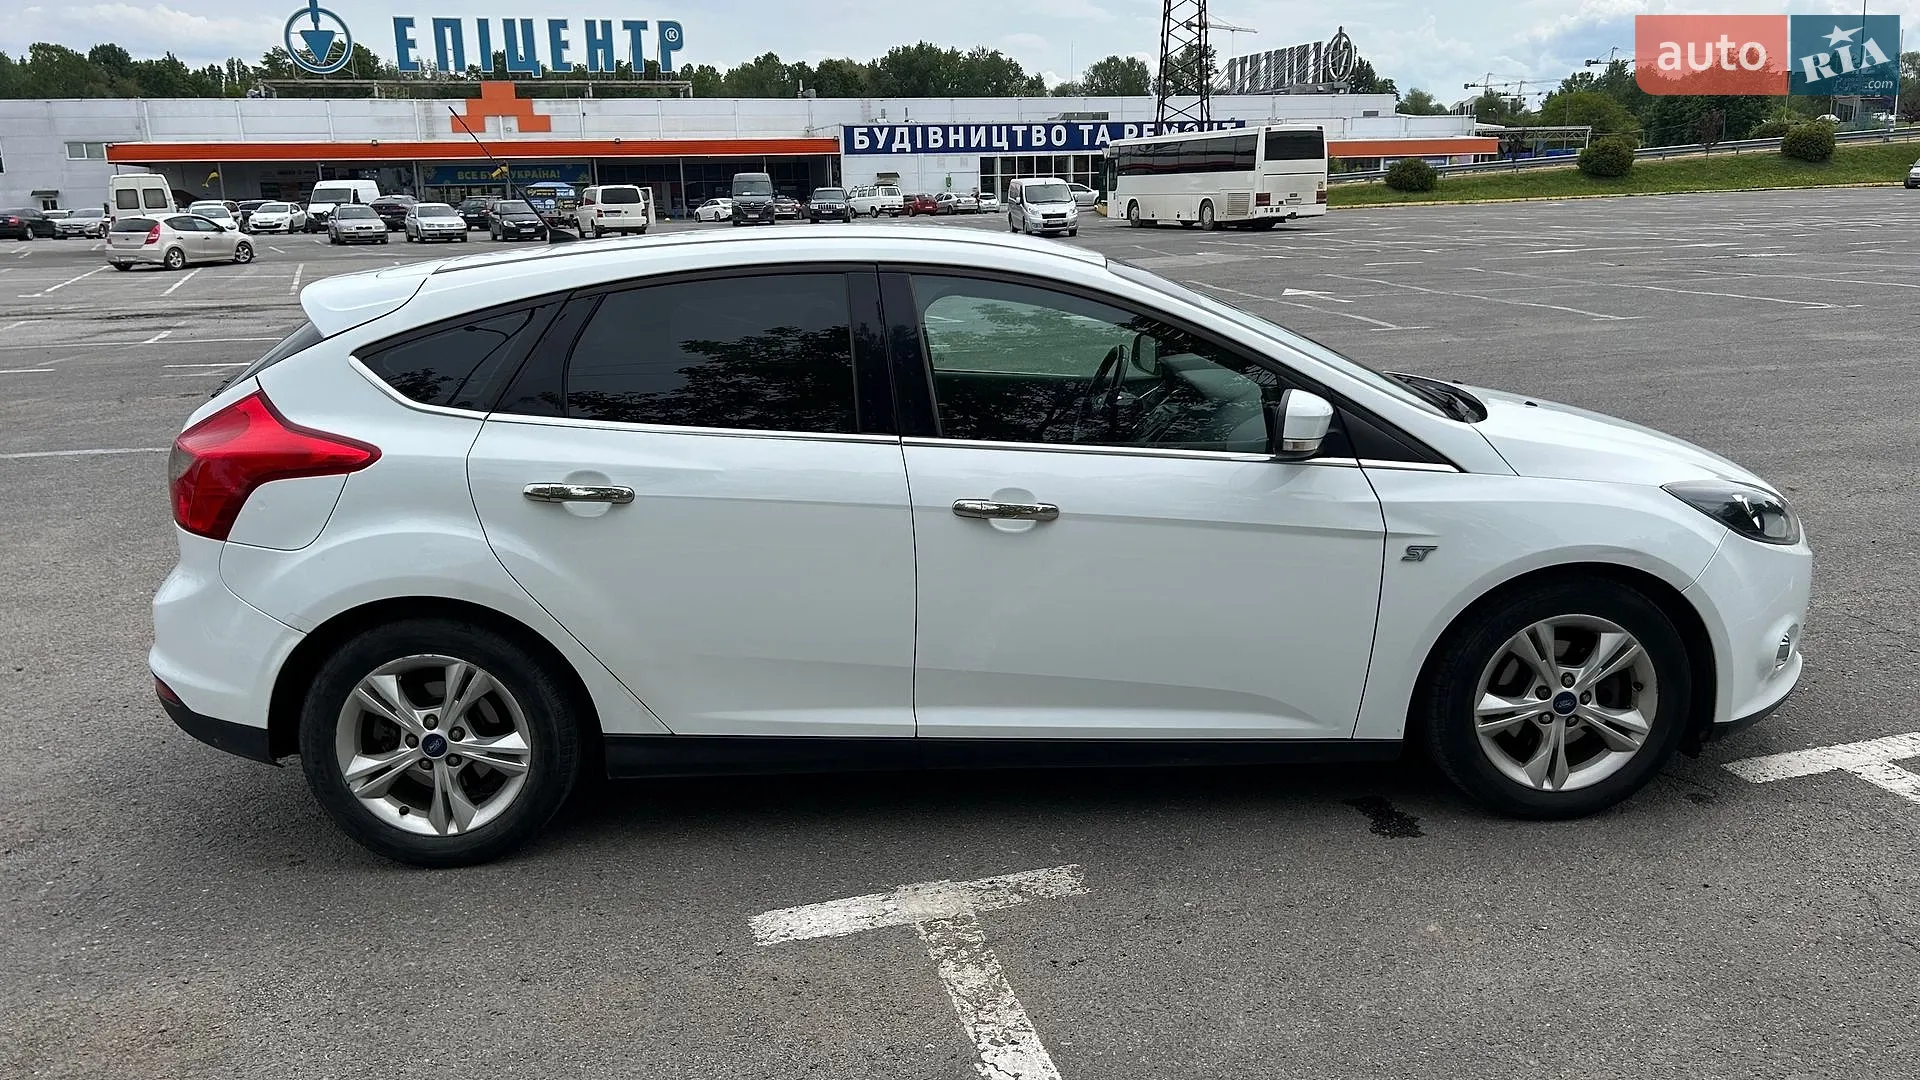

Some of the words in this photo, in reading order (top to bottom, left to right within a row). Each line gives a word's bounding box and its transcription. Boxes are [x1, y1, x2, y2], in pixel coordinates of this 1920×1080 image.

[392, 16, 684, 78] ЕПІЦЕНТР
[853, 124, 1067, 153] БУДІВНИЦТВО
[1079, 124, 1112, 146] ТА
[457, 171, 479, 180] ВСЕ
[510, 168, 561, 179] УКРАЇНА!
[1401, 545, 1439, 562] ST
